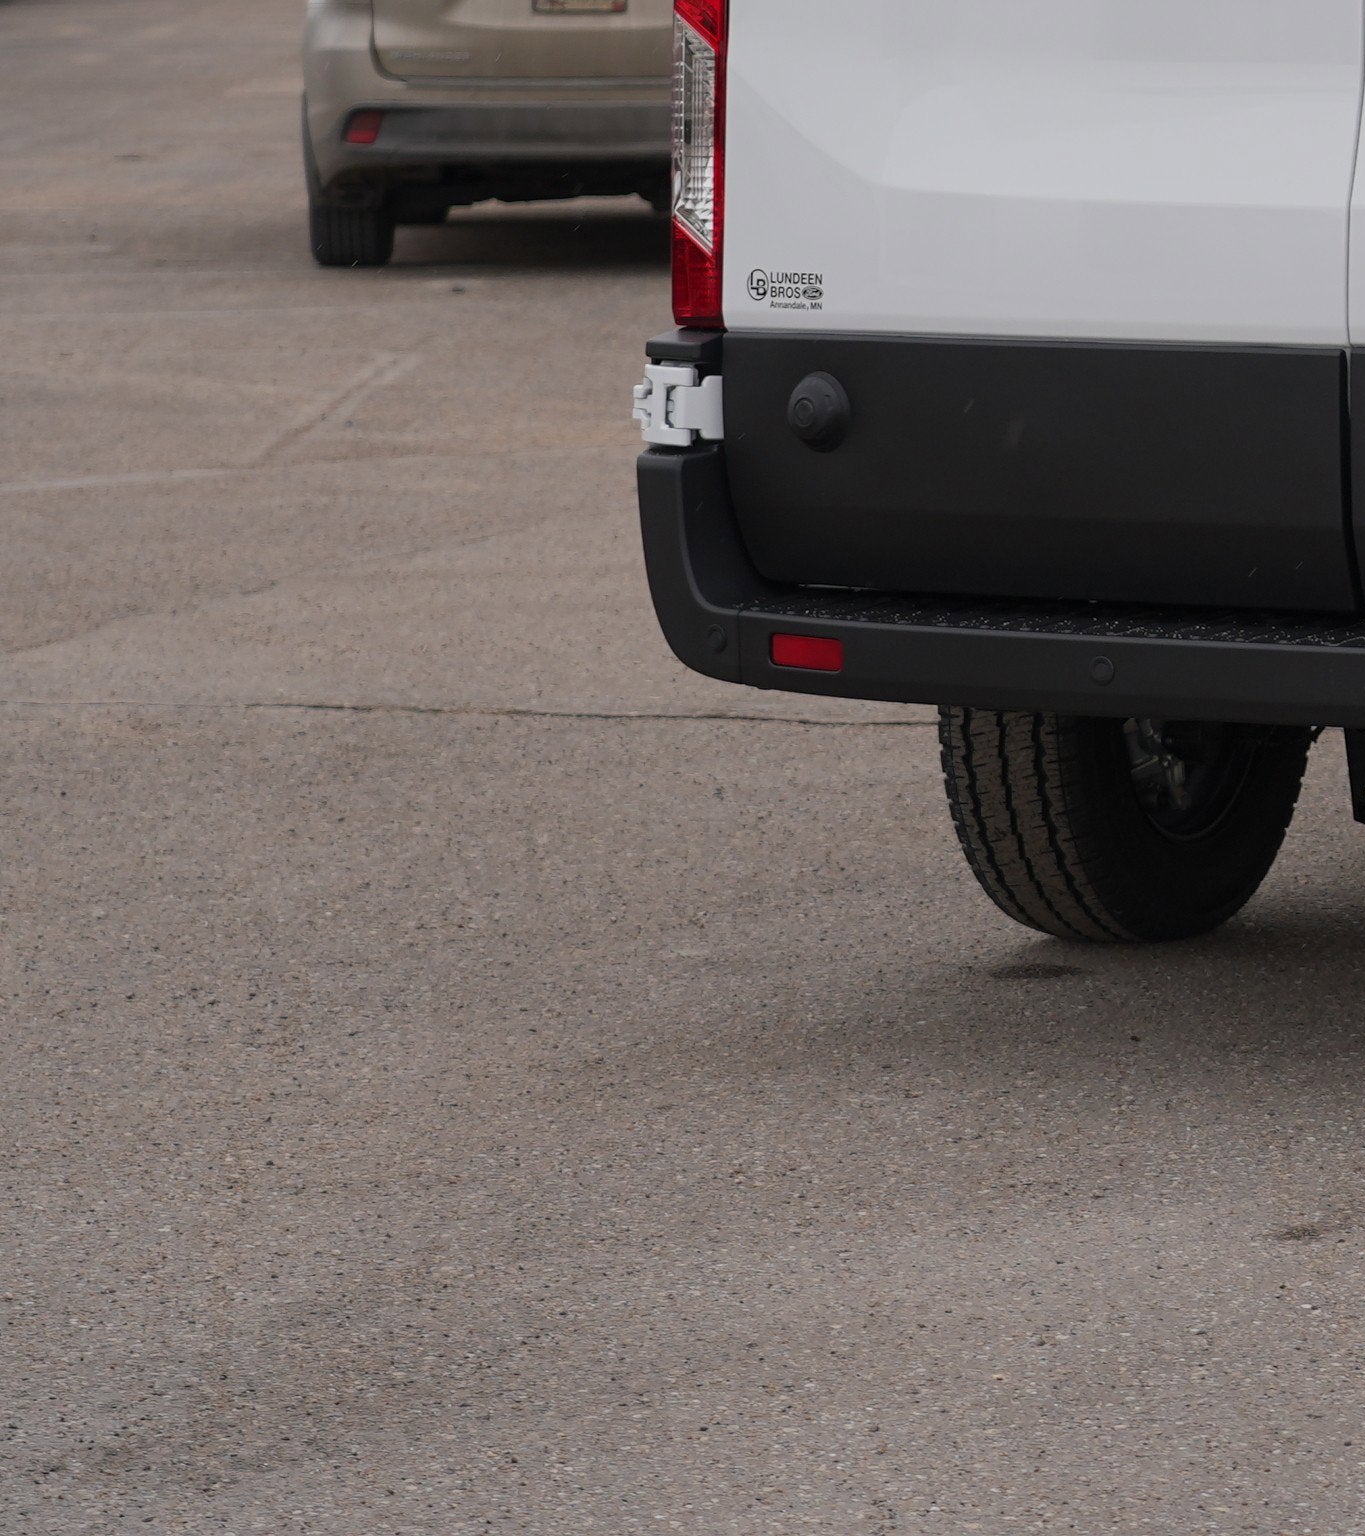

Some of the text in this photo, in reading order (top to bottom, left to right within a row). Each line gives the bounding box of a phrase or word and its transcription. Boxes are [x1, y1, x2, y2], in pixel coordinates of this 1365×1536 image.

[770, 272, 822, 285] LUNDEEN
[770, 286, 801, 298] BROS
[810, 302, 822, 310] MN
